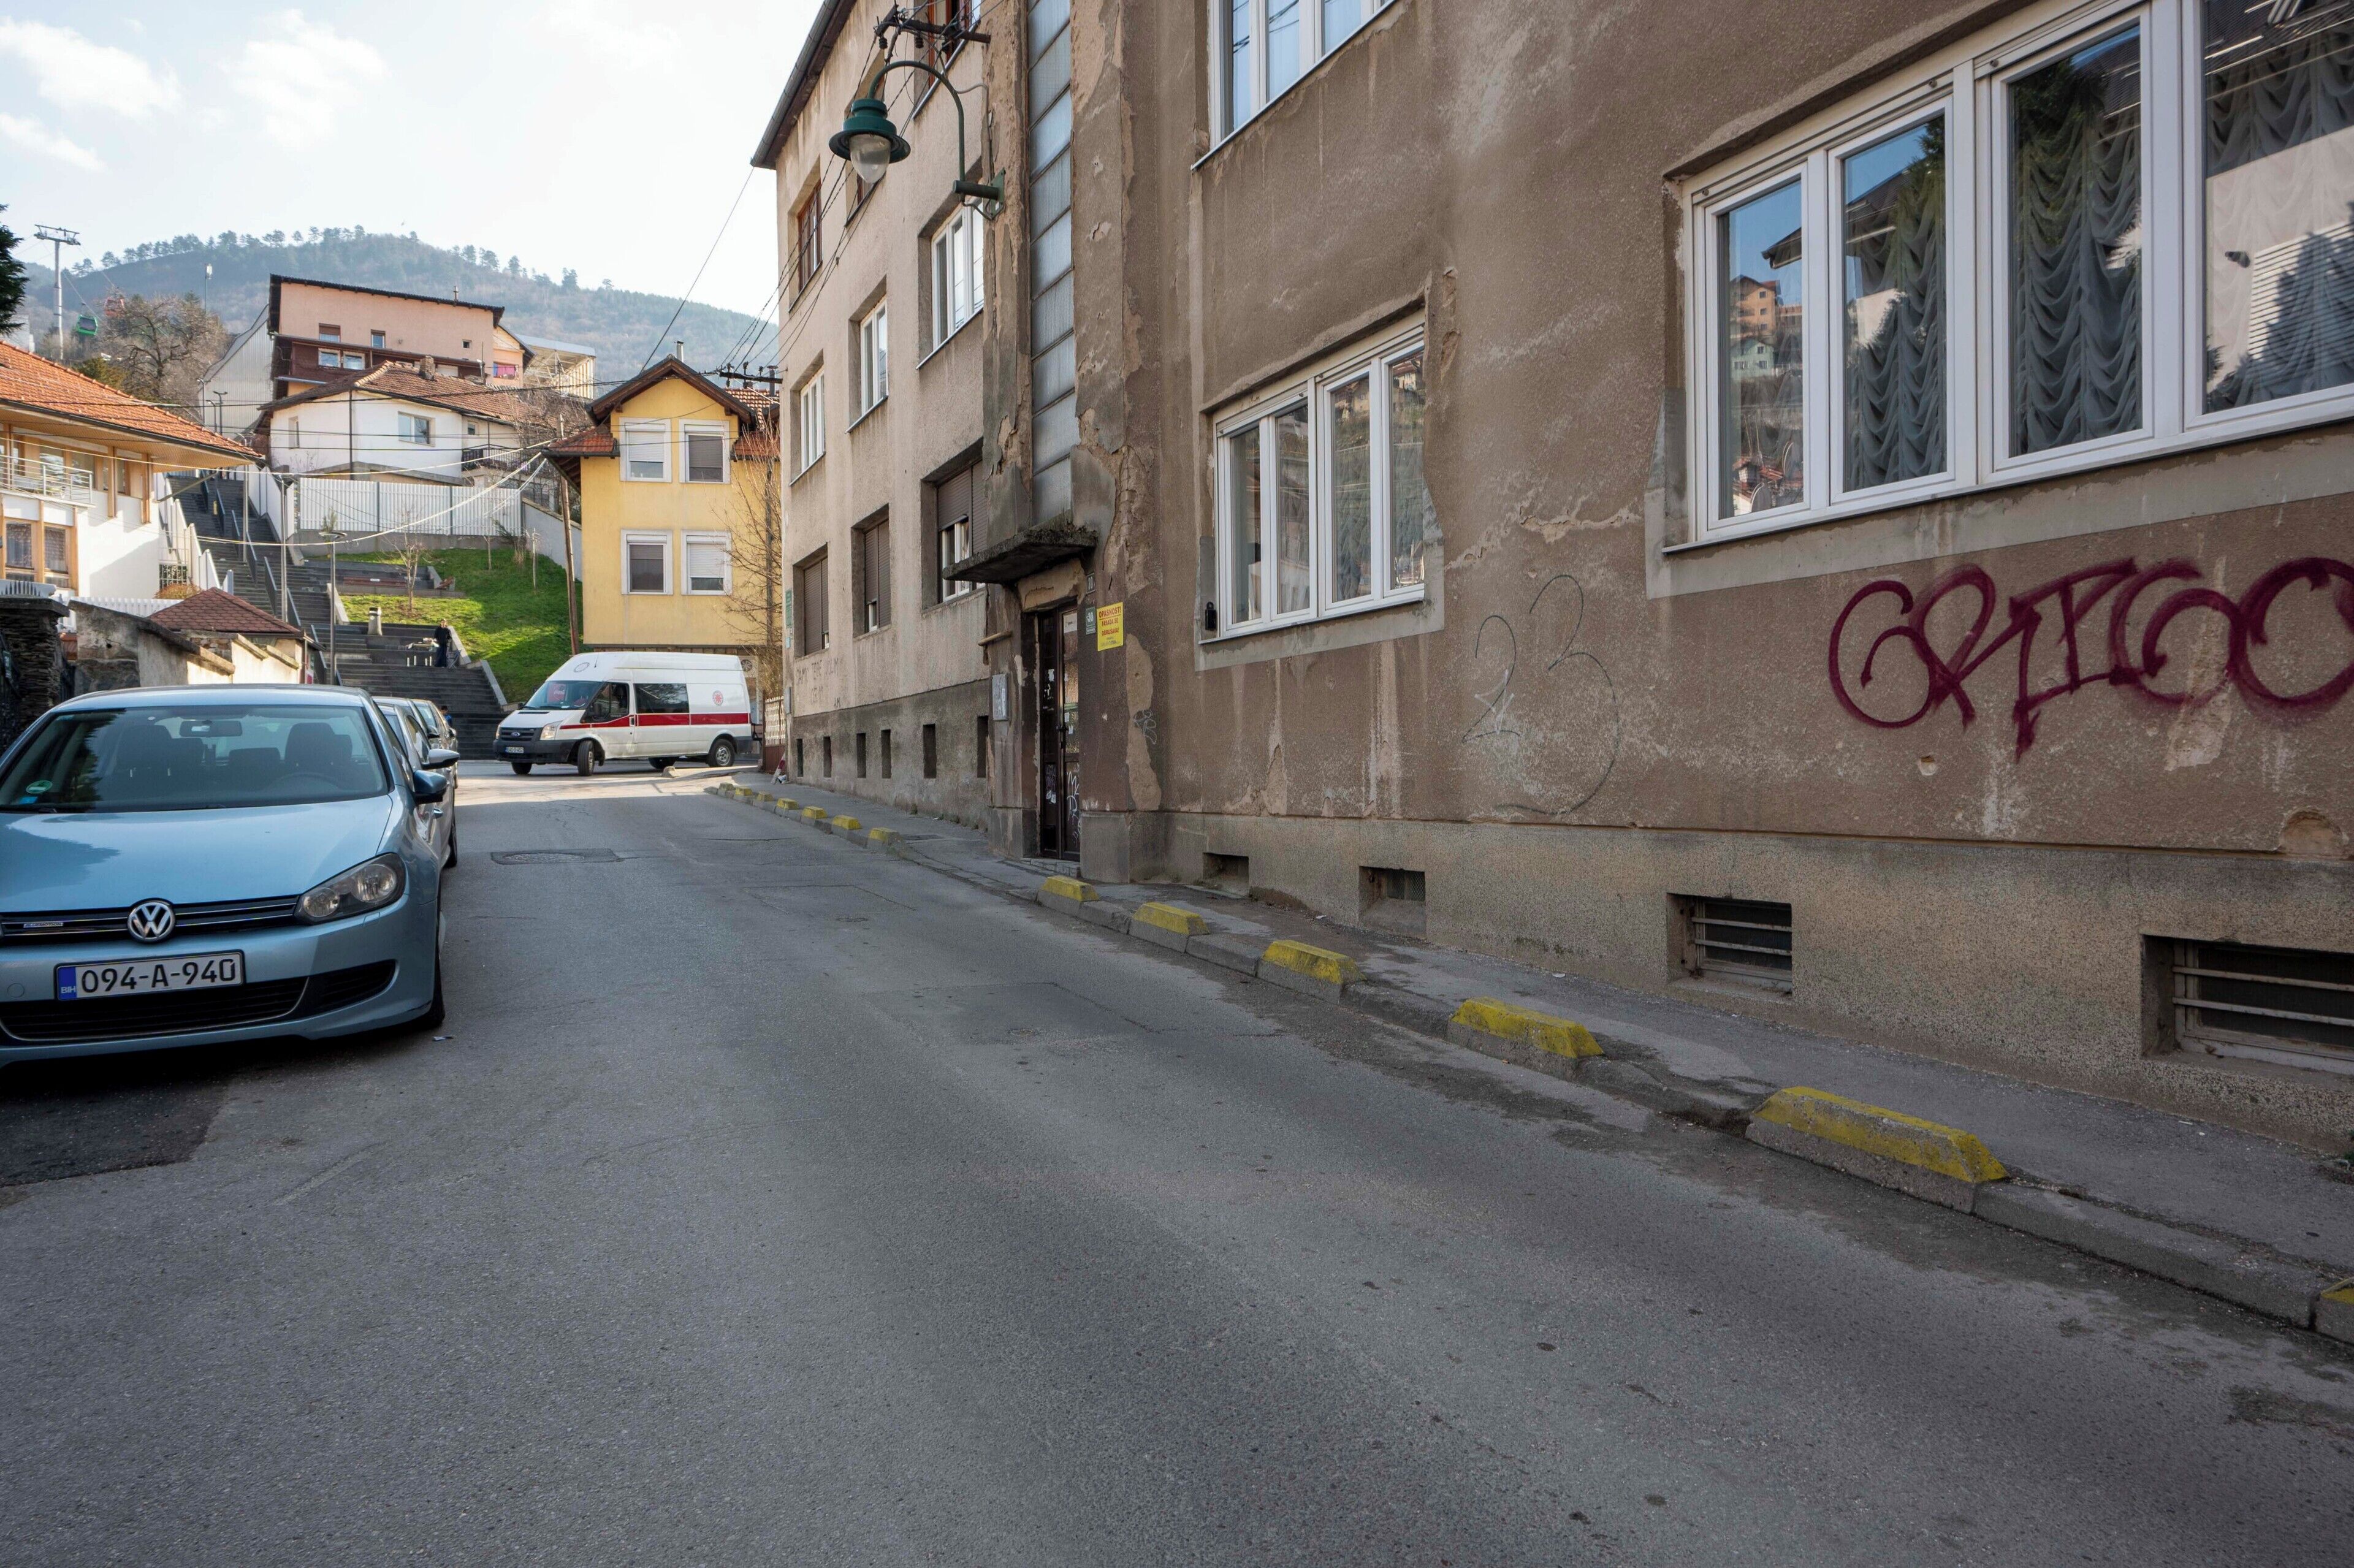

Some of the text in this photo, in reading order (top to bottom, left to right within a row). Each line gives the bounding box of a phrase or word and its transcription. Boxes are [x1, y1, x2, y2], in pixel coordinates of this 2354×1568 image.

[1099, 606, 1121, 618] OPASNOST!
[1102, 618, 1114, 627] FASADA
[131, 901, 172, 939] VW
[82, 958, 236, 993] 094-A-940
[61, 986, 76, 994] BIH
